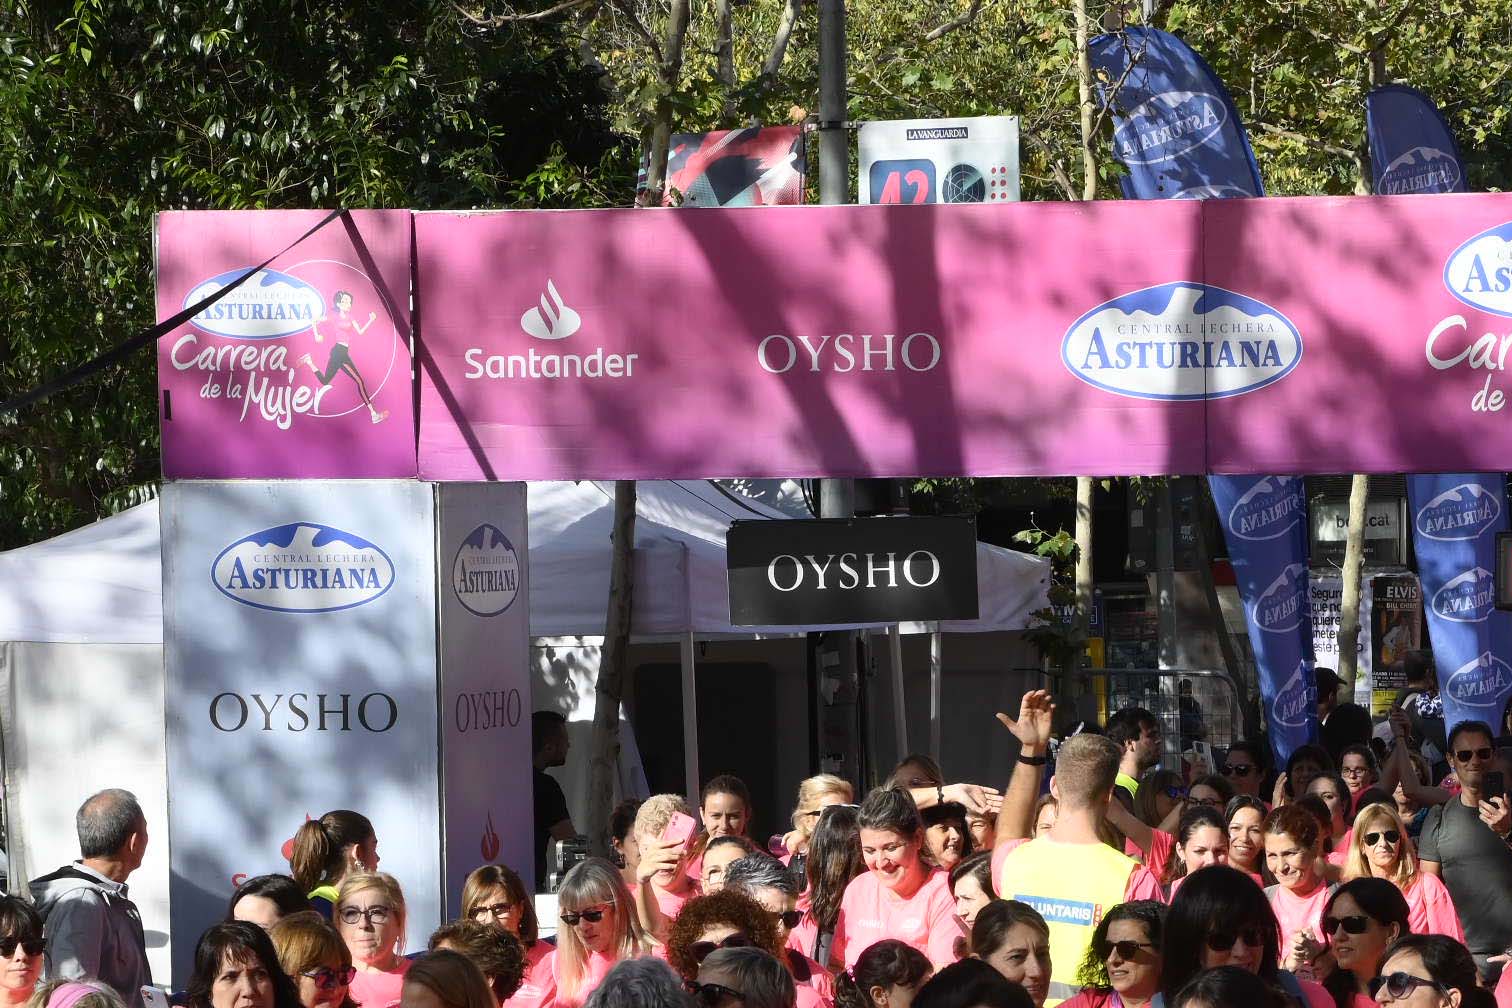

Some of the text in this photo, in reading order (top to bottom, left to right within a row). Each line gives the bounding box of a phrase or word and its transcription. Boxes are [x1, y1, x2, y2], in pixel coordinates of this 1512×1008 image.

[1118, 322, 1274, 334] CENTRAL LECHERA
[171, 334, 288, 371] Carrera
[465, 347, 638, 378] Santander
[757, 333, 941, 373] OYSHO
[1081, 327, 1283, 369] ASTURIANA
[200, 368, 332, 430] de la Mujer
[1471, 374, 1506, 412] de
[226, 556, 382, 590] ASTURIANA
[254, 554, 375, 563] CENTRAL LECHERA
[458, 559, 516, 593] ASTURIANA
[767, 550, 940, 591] OYSHO
[1312, 586, 1342, 600] Segur
[1387, 586, 1416, 598] ELVIS
[1312, 616, 1341, 628] quiere
[209, 692, 398, 732] OYSHO
[455, 688, 521, 732] OYSHO
